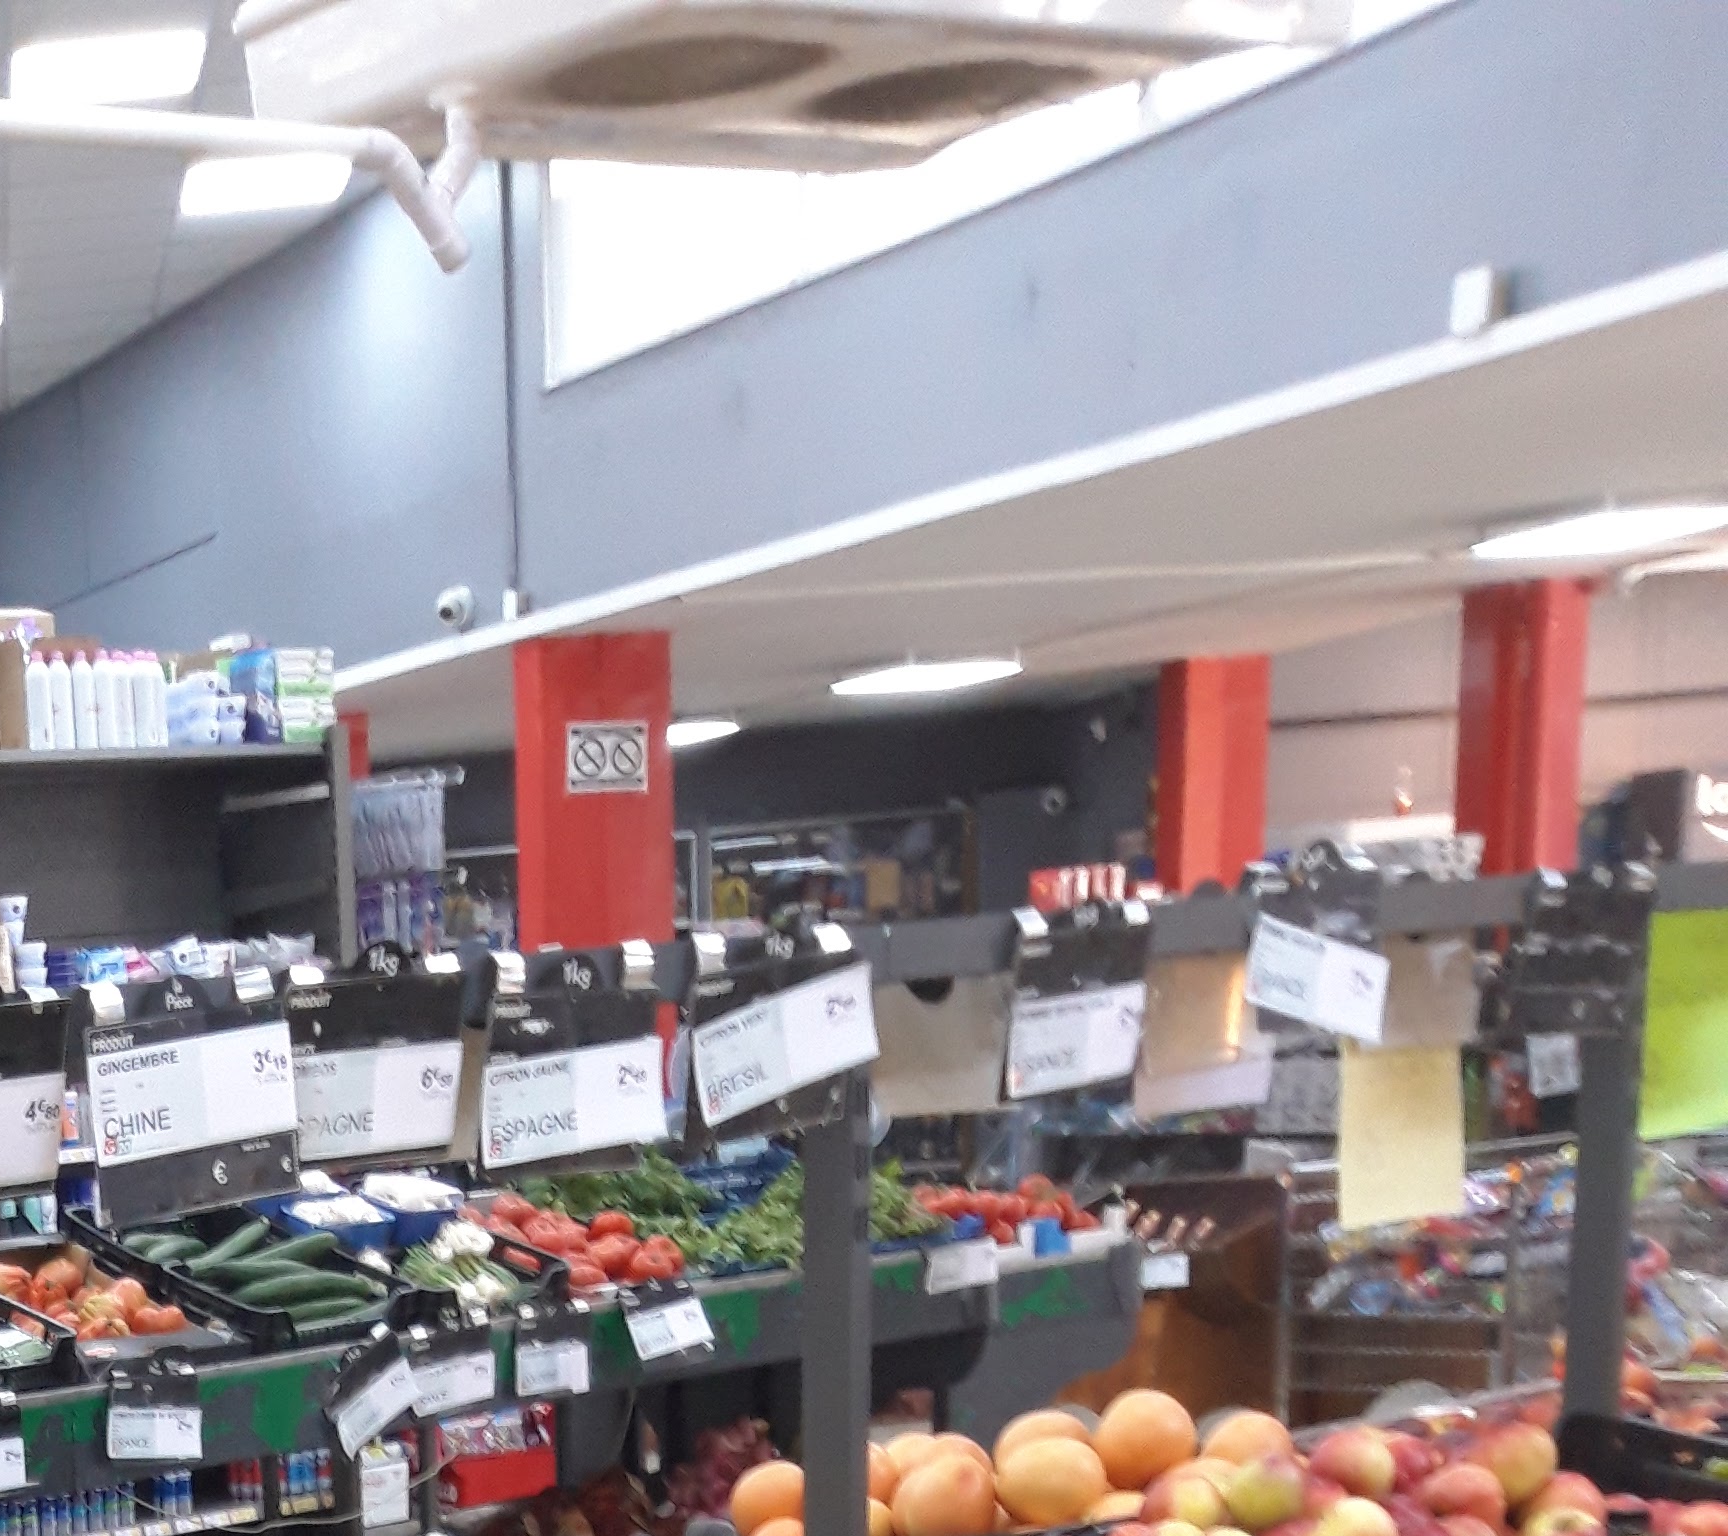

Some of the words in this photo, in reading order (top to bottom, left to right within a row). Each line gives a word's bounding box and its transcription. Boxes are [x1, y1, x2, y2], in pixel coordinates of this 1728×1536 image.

[92, 1034, 135, 1053] PRODUIT
[97, 1050, 180, 1077] GINGEMBRE
[104, 1108, 172, 1139] CHINE
[299, 1111, 374, 1136] PAGNE
[491, 1108, 578, 1142] ESPAGNE
